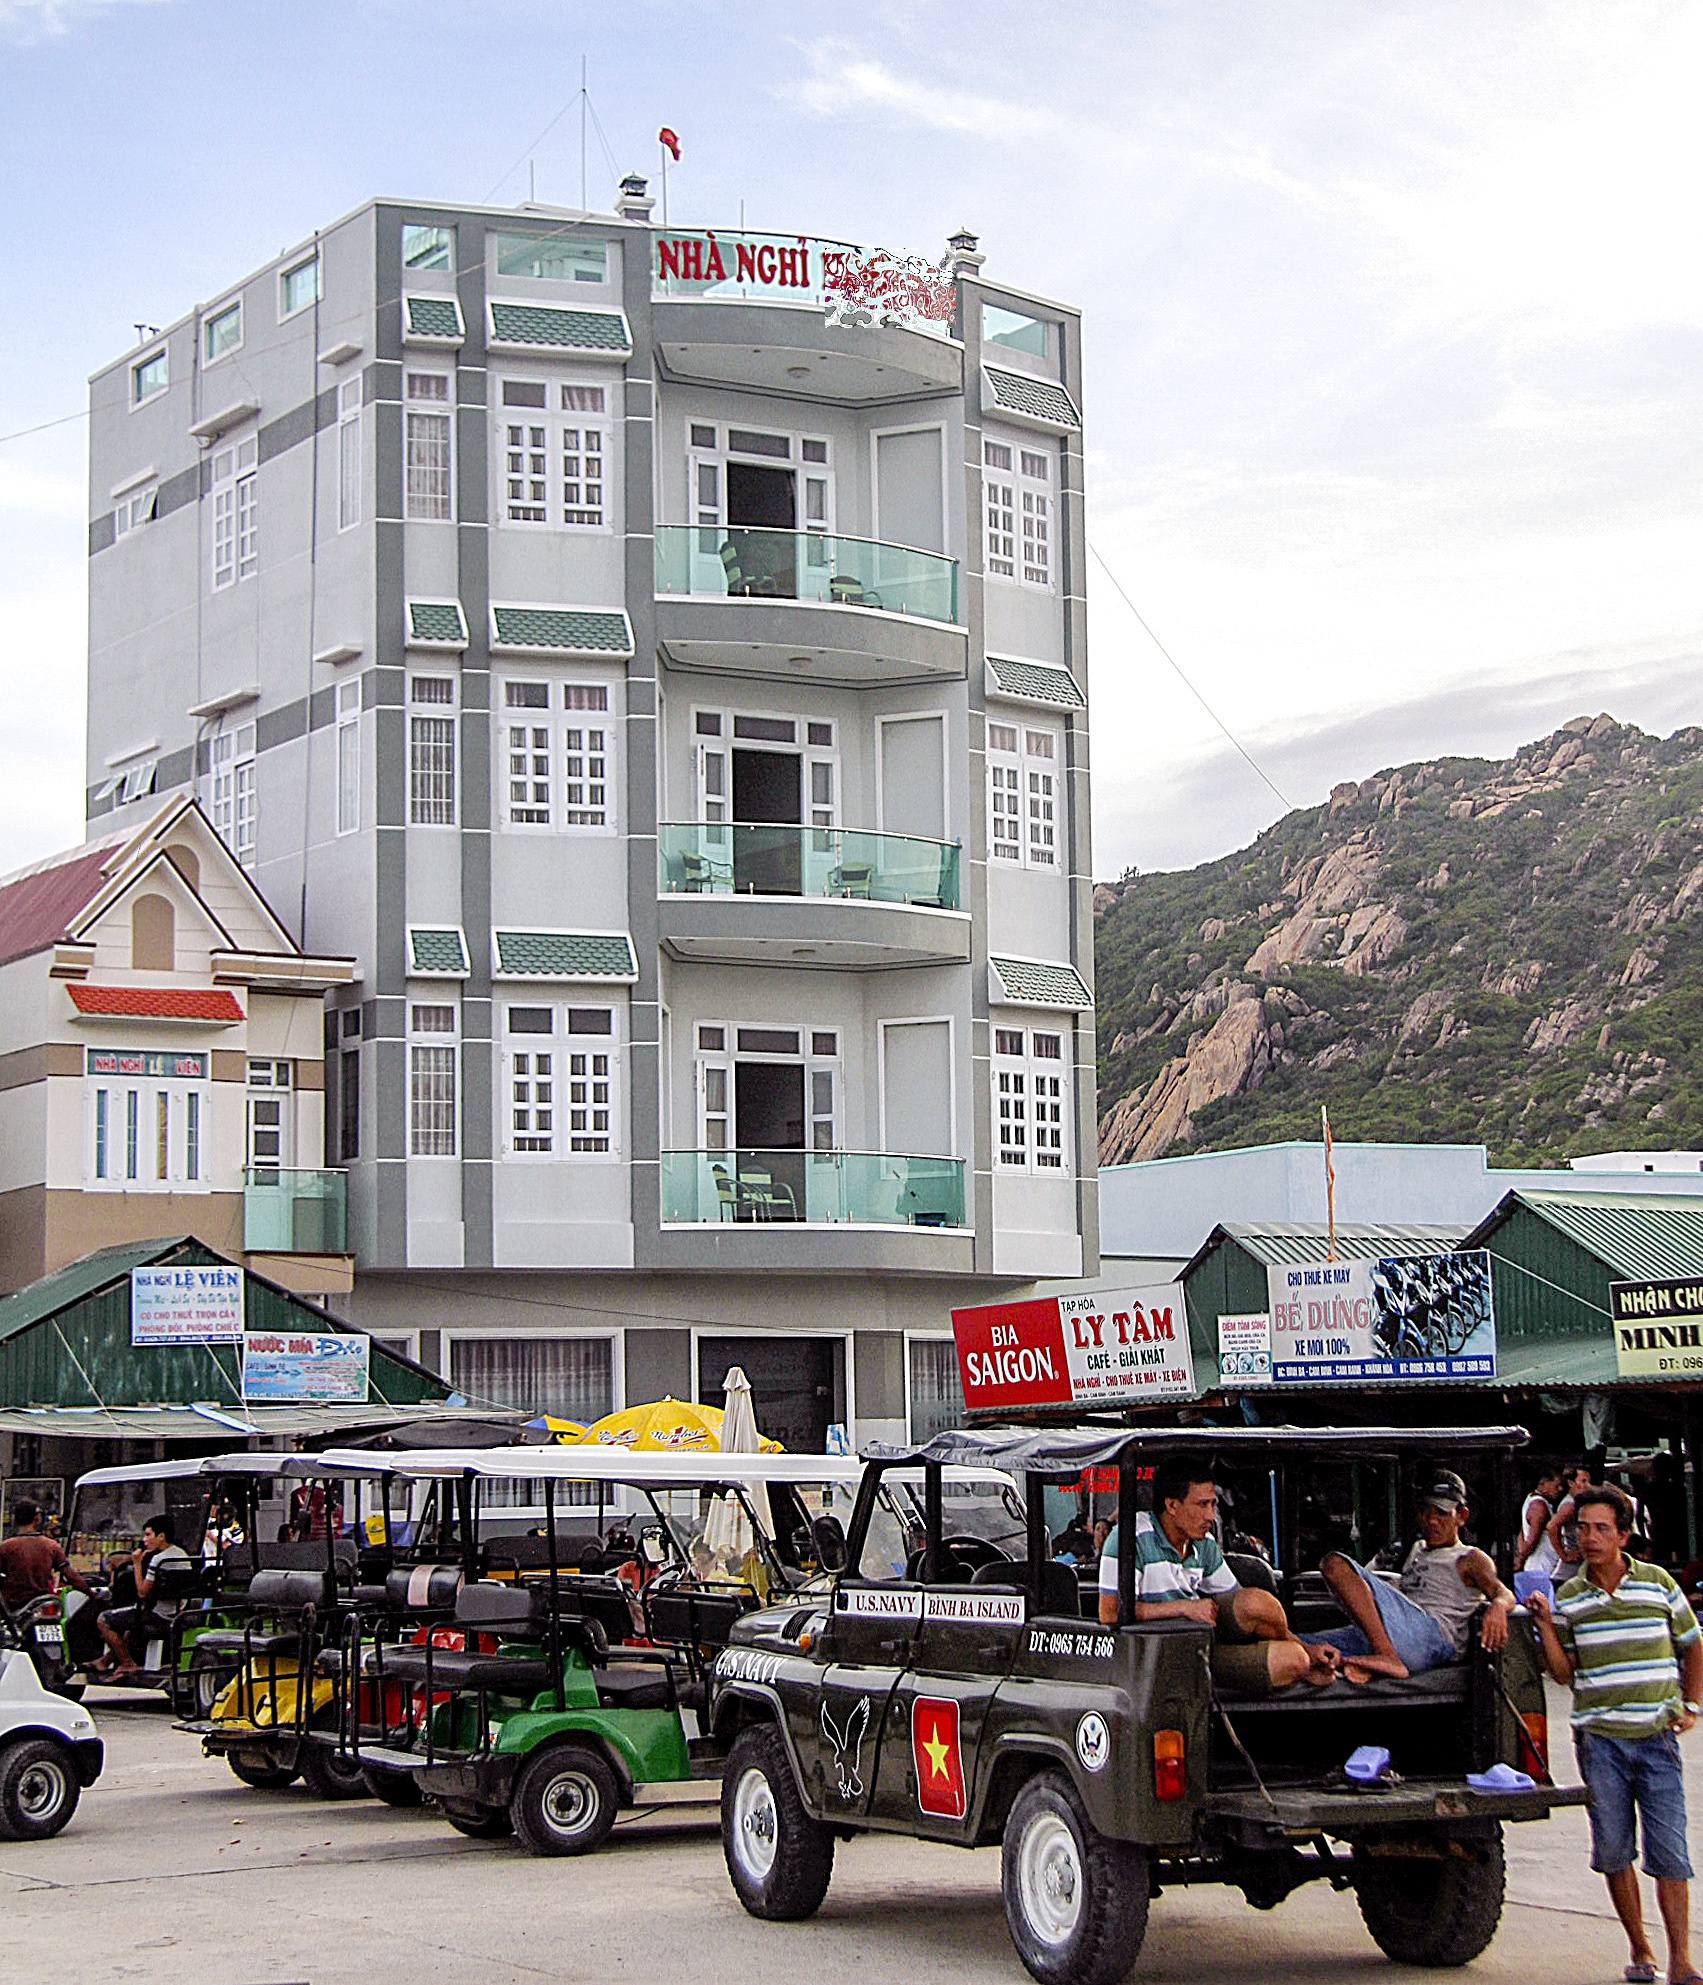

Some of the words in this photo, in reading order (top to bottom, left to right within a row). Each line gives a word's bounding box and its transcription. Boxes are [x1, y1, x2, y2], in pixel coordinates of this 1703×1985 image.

[658, 230, 726, 280] NHÀ
[736, 236, 810, 287] NGHỈ
[175, 1269, 194, 1291] LỆ
[198, 1269, 239, 1287] VIÊN
[1287, 1272, 1302, 1286] CHO
[1323, 1269, 1332, 1284] XE
[1061, 1300, 1076, 1314] TẠP
[1078, 1297, 1096, 1311] HÓA
[1620, 1286, 1671, 1315] NHẬN
[991, 1324, 1019, 1347] BIA
[1071, 1314, 1105, 1349] LY
[1112, 1300, 1175, 1345] TÂM
[1295, 1340, 1305, 1356] XE
[1326, 1338, 1350, 1355] 100%
[1620, 1325, 1702, 1351] MINH
[966, 1346, 1055, 1386] SAIGON
[1087, 1350, 1111, 1370] CAFÉ
[1119, 1346, 1139, 1367] GIẢI
[1140, 1345, 1165, 1364] KHÁT
[1660, 1358, 1680, 1370] ĐT:
[1105, 1375, 1118, 1387] CHO
[1135, 1373, 1142, 1385] XE
[1162, 1370, 1171, 1382] XE
[856, 1595, 916, 1612] U.S.NAVY
[928, 1596, 956, 1616] BÌNH
[958, 1600, 974, 1617] BA
[976, 1601, 1020, 1619] ISLAND
[1075, 1634, 1093, 1656] 754
[1094, 1635, 1115, 1658] 566
